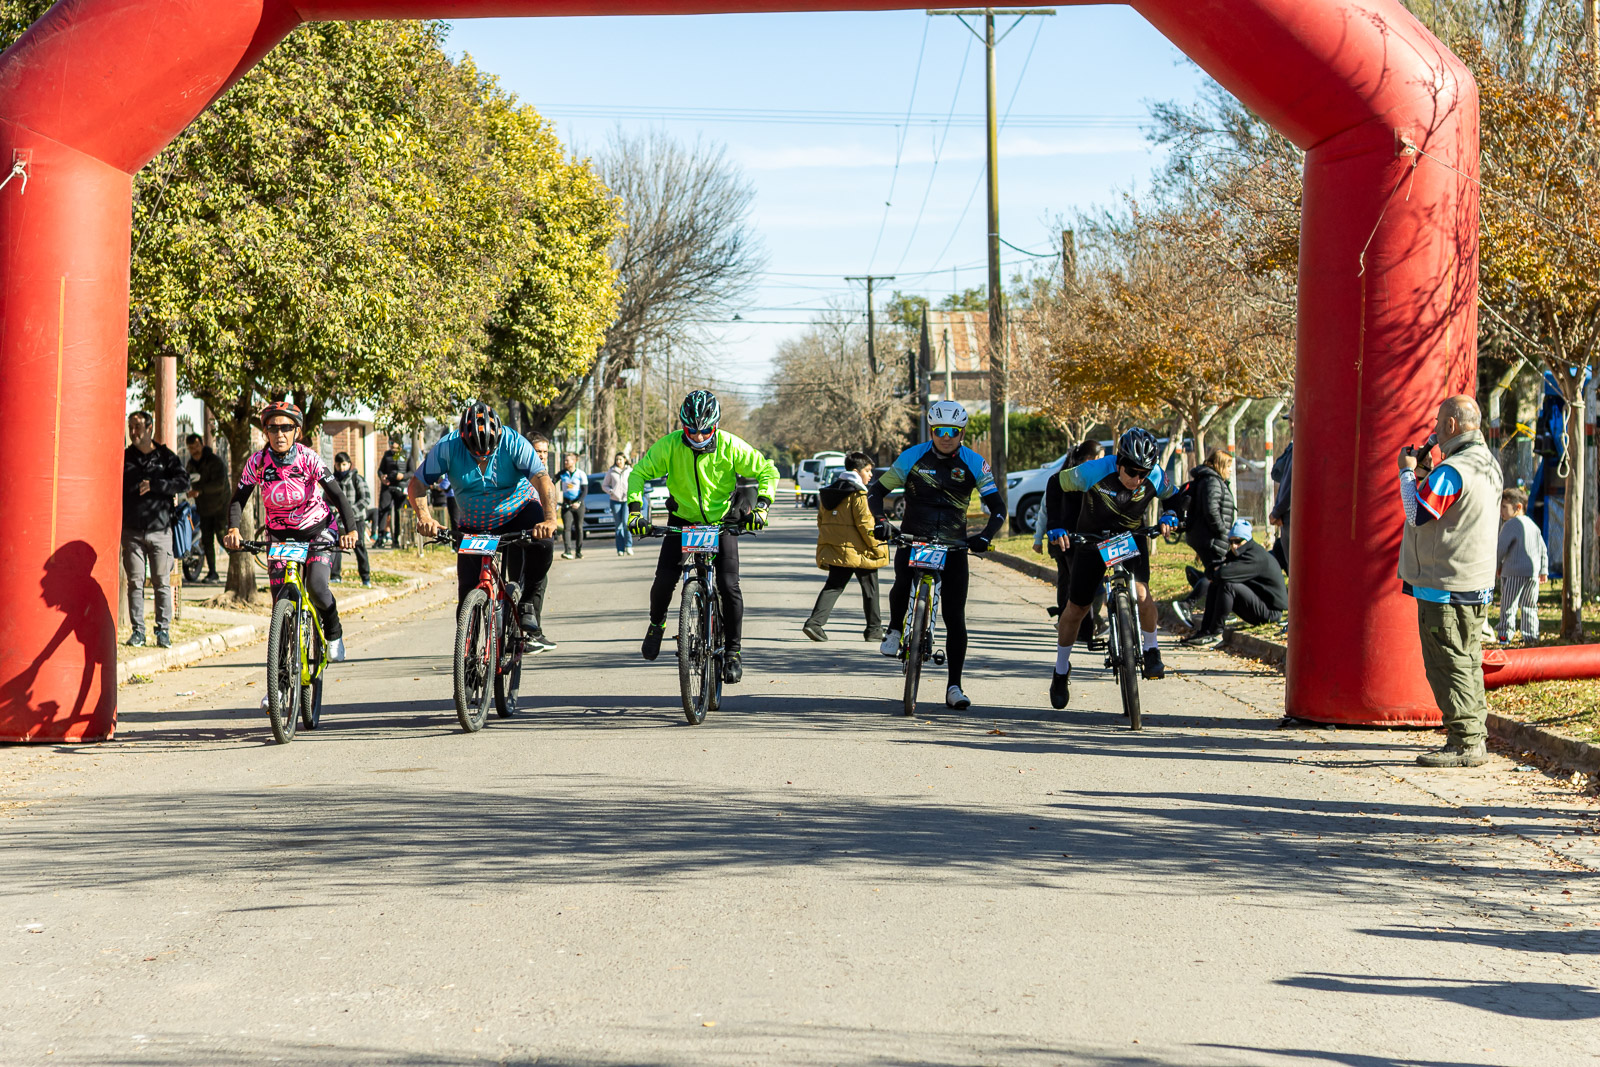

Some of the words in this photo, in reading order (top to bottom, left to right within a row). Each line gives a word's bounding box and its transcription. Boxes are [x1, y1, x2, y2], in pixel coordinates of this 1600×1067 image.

[468, 540, 489, 550] 10
[1107, 540, 1129, 560] 62
[273, 546, 304, 558] 173
[914, 549, 945, 564] 178
